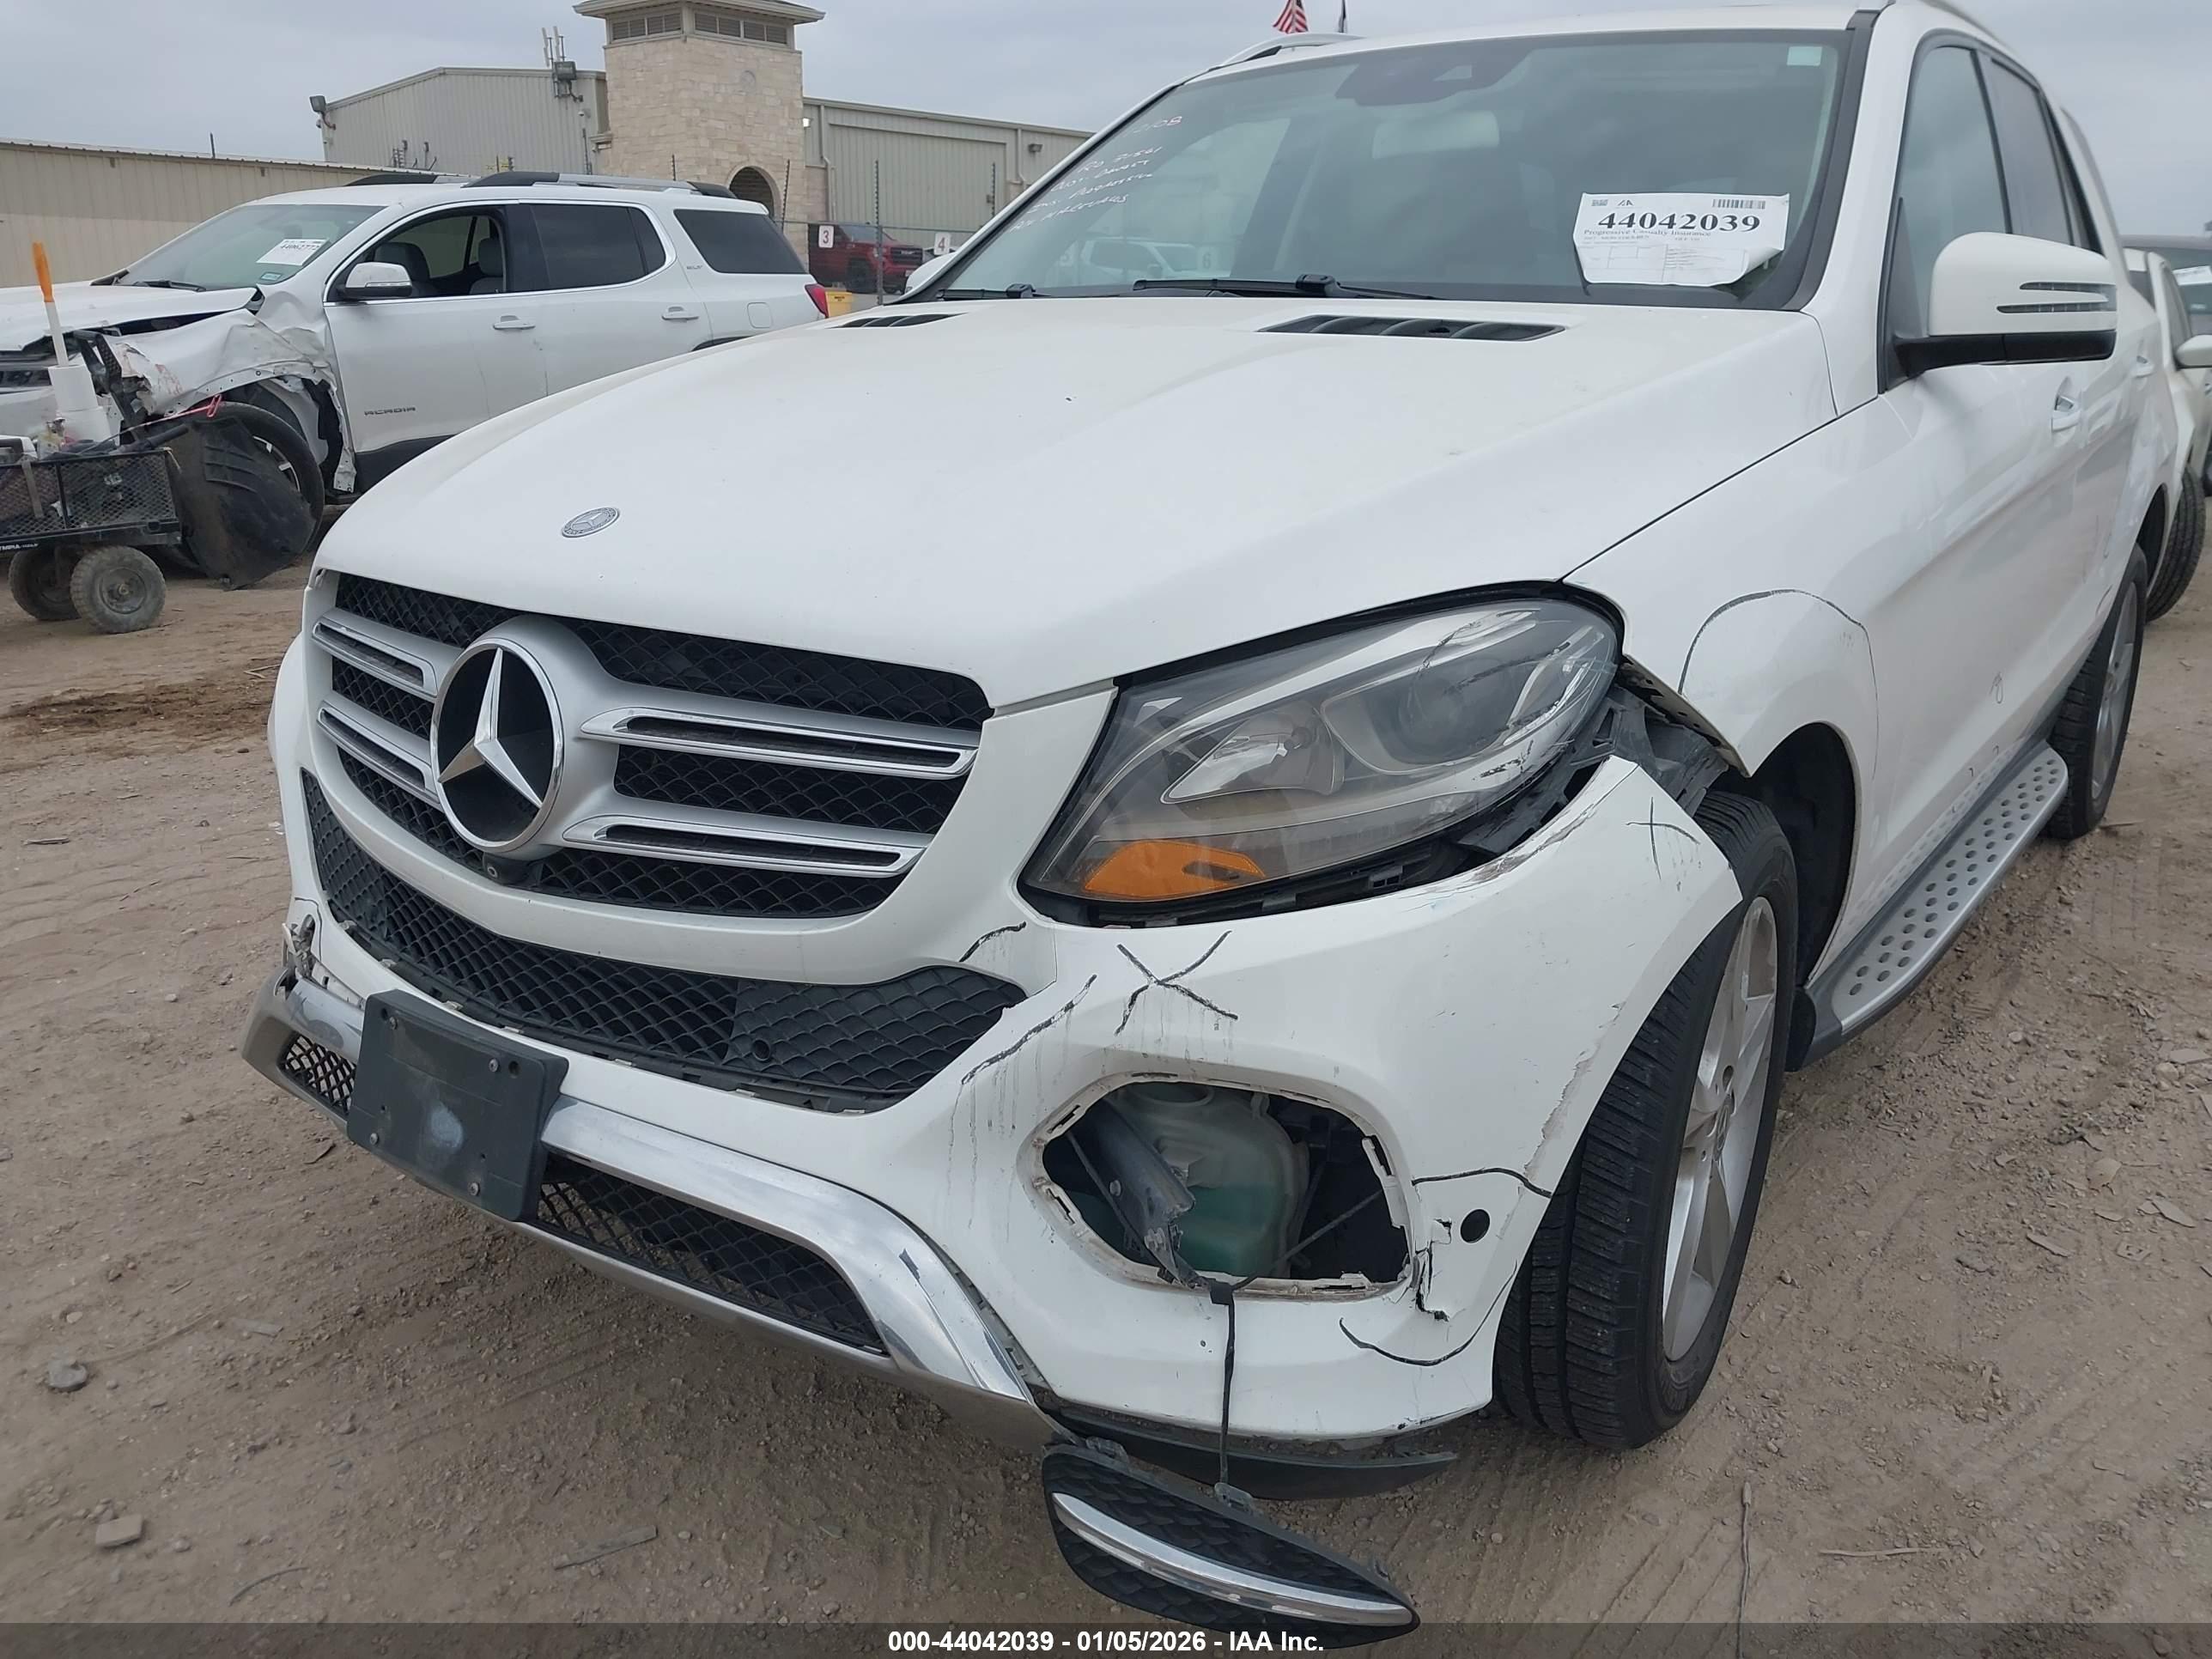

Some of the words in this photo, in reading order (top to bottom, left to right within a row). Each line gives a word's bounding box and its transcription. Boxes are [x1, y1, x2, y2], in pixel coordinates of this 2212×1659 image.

[1598, 212, 1760, 232] 44042039
[823, 230, 830, 244] 3
[1583, 228, 1631, 237] Progressive
[938, 237, 945, 251] 4
